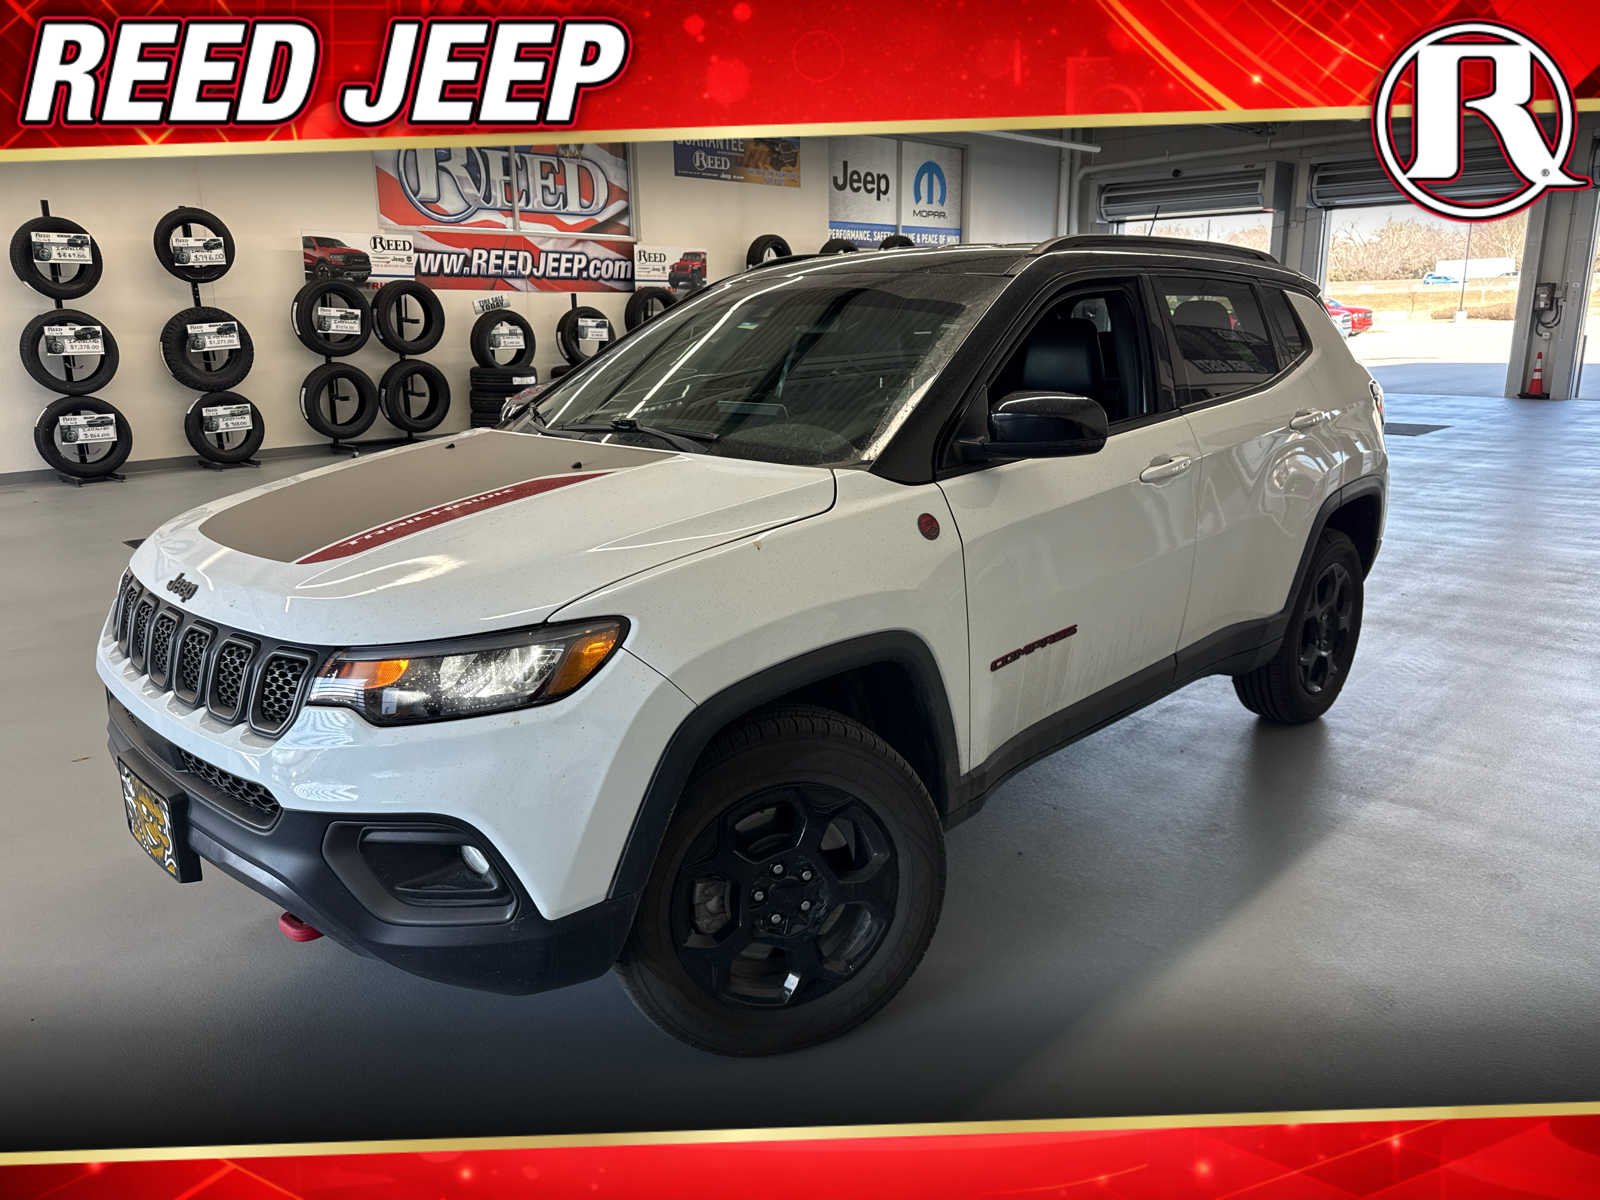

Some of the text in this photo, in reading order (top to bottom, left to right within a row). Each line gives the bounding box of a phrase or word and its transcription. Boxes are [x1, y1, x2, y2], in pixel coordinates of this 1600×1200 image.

[692, 150, 730, 170] REED
[397, 145, 609, 223] REED
[832, 160, 890, 201] Jeep
[912, 208, 947, 219] MOPAR
[370, 235, 413, 253] REED
[637, 248, 667, 265] REED
[339, 488, 514, 547] TRAILHAWK
[166, 572, 199, 603] Jeep
